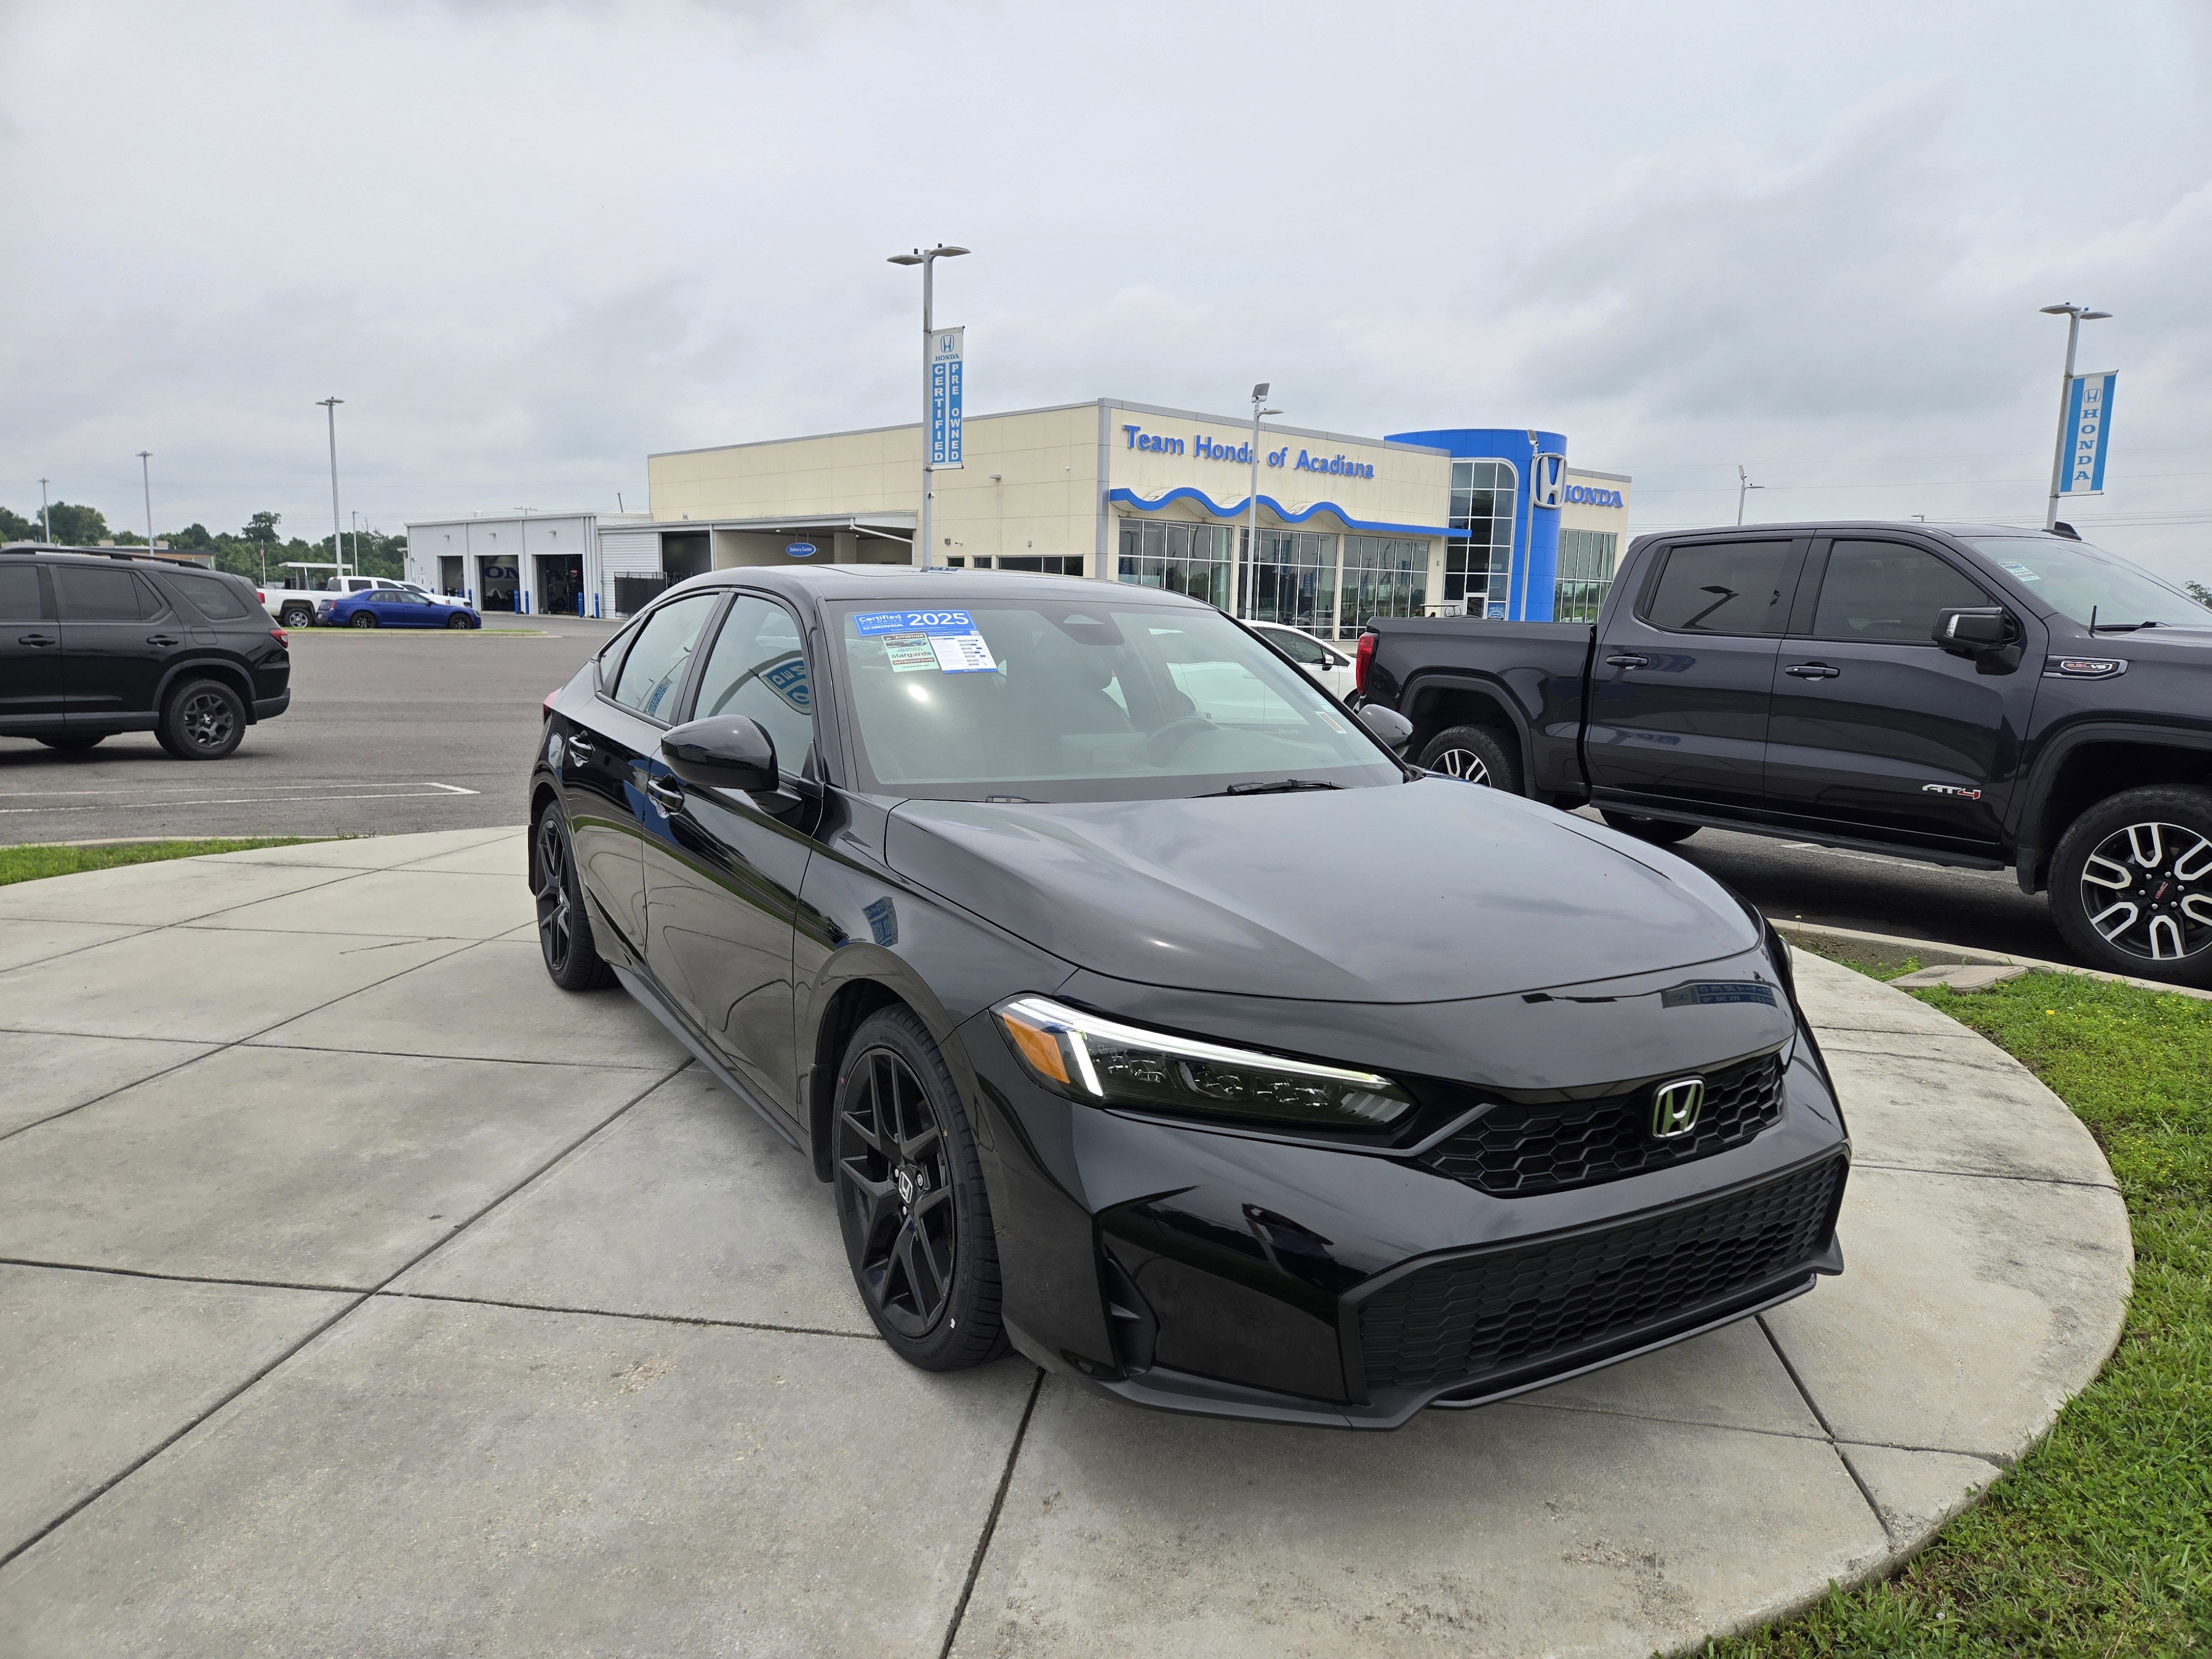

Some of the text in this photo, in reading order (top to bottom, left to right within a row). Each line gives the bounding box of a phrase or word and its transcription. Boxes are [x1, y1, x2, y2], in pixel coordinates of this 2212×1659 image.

[935, 353, 959, 362] HONDA
[934, 365, 944, 461] CERTIFIED
[950, 363, 961, 461] PRE OWNED
[1123, 424, 1185, 455] Team
[1267, 446, 1288, 467] of
[1294, 449, 1375, 478] Acadiana
[2074, 409, 2099, 481] HONDA
[859, 612, 969, 626] Certified 2025
[1922, 784, 1981, 800] AT4
[2154, 881, 2168, 900] GMC
